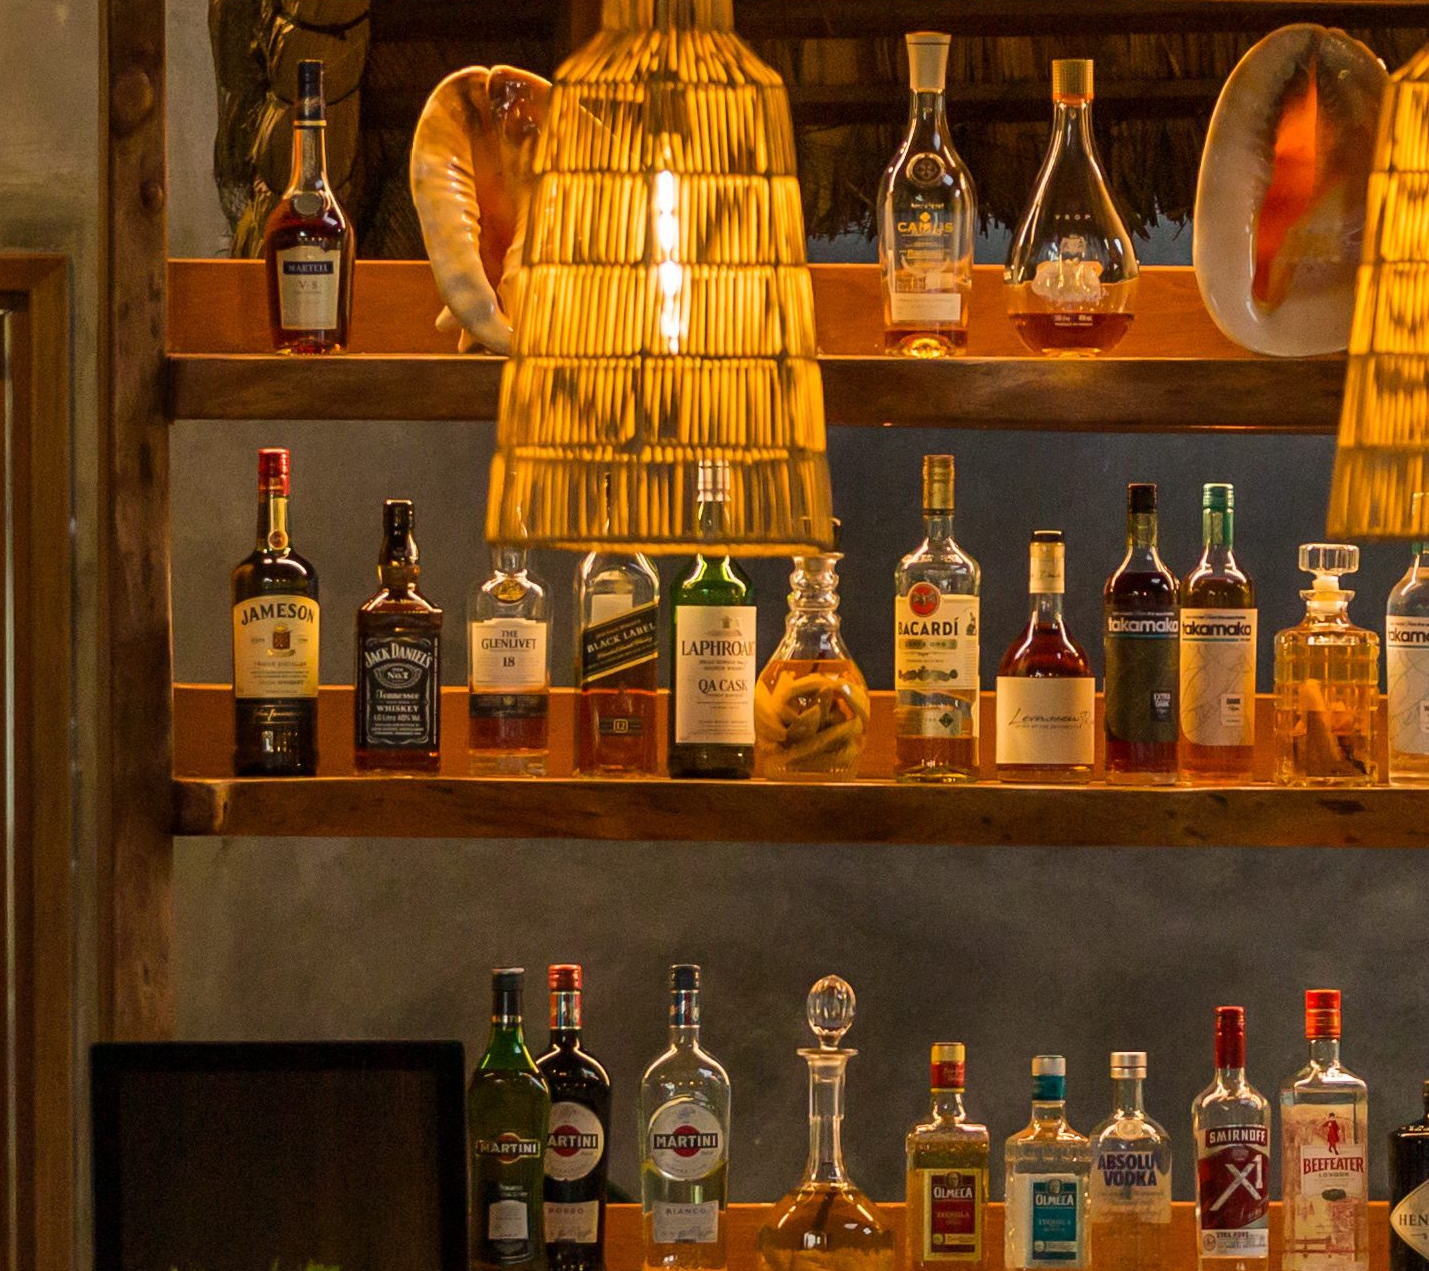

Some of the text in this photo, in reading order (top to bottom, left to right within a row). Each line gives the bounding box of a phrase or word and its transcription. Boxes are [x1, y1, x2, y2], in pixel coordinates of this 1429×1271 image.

[897, 222, 954, 233] CAMUS
[241, 603, 314, 626] JAMESON
[898, 617, 959, 636] BACARDÍ
[1107, 616, 1179, 633] takamaka
[501, 630, 518, 638] THE
[585, 634, 622, 653] BLACK
[623, 622, 657, 640] LABEL
[481, 638, 537, 650] GLENLIVET
[364, 642, 433, 669] JACK DANIEL'S
[501, 656, 516, 667] 18
[698, 678, 748, 694] QA CASK
[376, 689, 420, 699] Tennessee
[376, 705, 419, 713] WHISKEY
[547, 1135, 597, 1148] ARTINI
[655, 1135, 717, 1148] MARTINI
[1209, 1129, 1266, 1144] SMIRNOFF
[479, 1142, 537, 1154] MARTINI
[1303, 1156, 1364, 1175] BEEFEATER
[1103, 1170, 1158, 1186] VODKA
[933, 1186, 973, 1199] OLMECA
[1035, 1193, 1075, 1206] OLMECA
